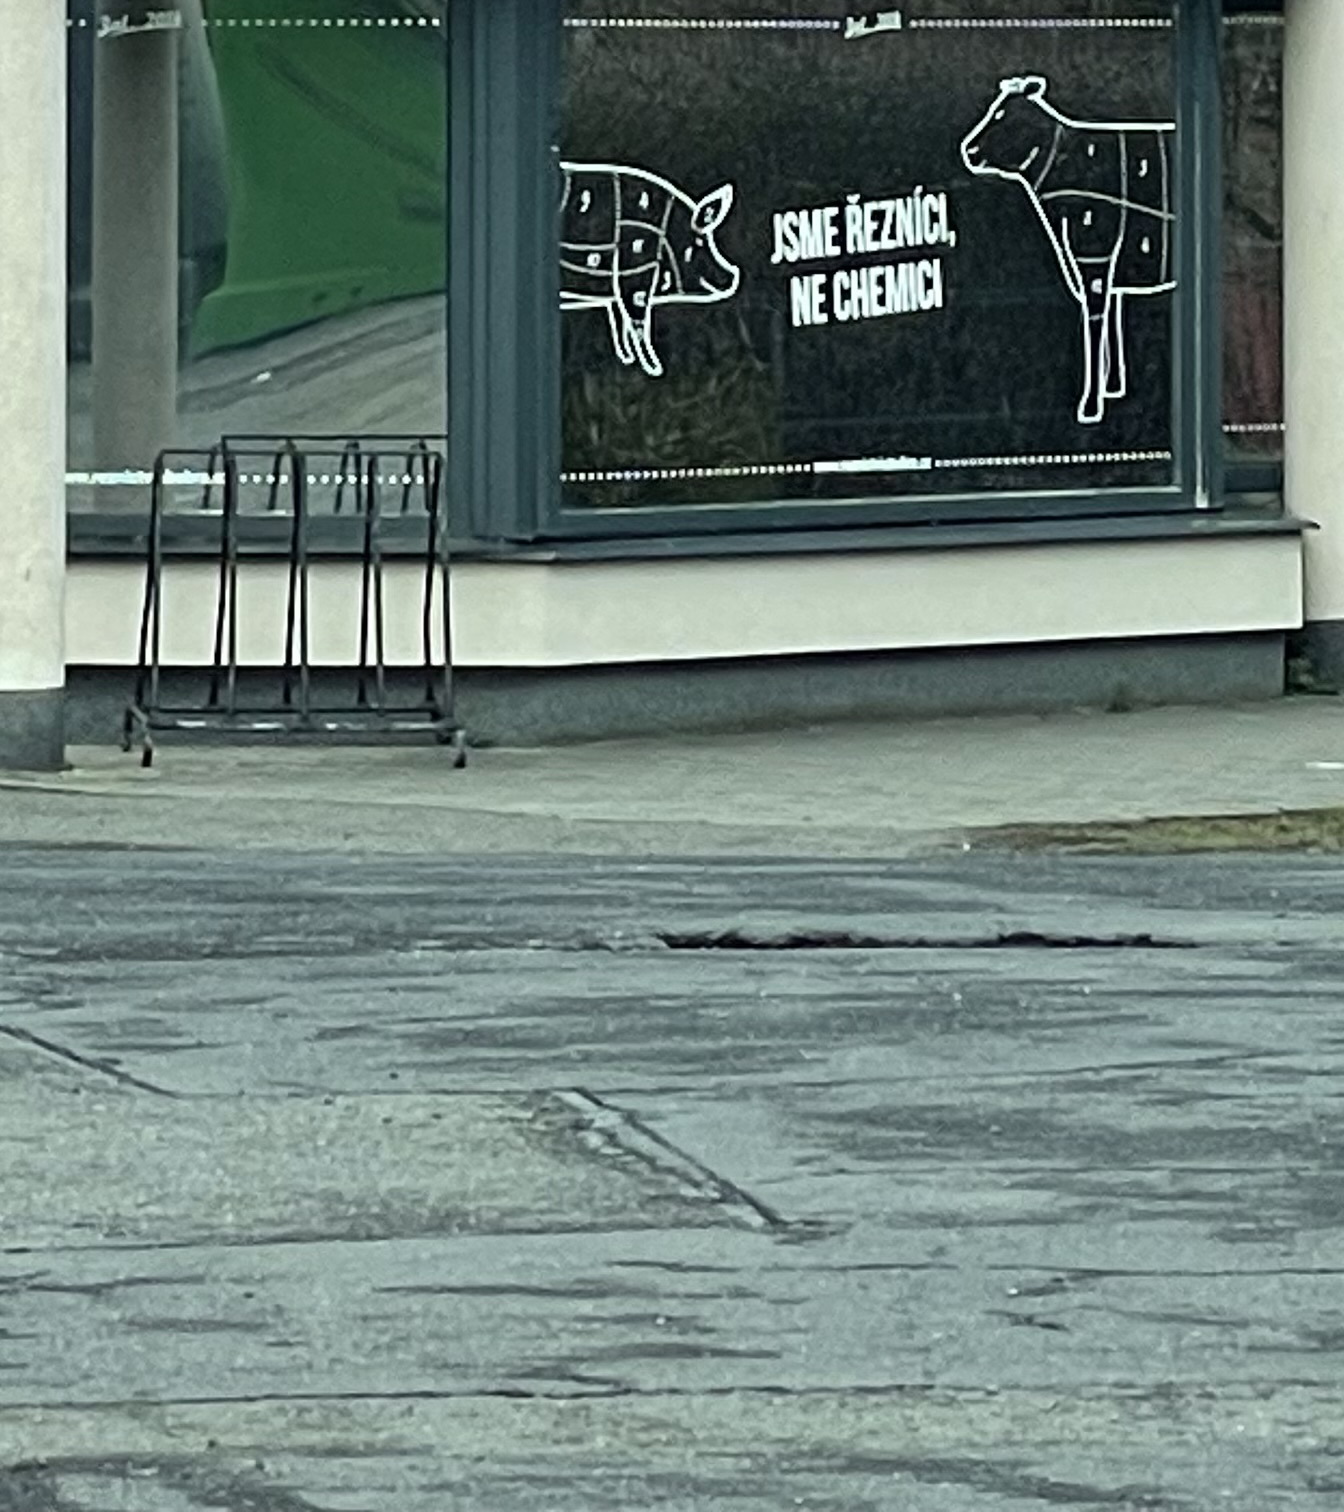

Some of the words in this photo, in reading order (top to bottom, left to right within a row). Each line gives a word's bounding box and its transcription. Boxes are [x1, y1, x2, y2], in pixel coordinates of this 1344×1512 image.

[770, 206, 841, 264] JSME
[845, 185, 956, 254] ŘEZNÍCI,
[790, 274, 828, 327] NE
[833, 258, 943, 322] CHEMICI
